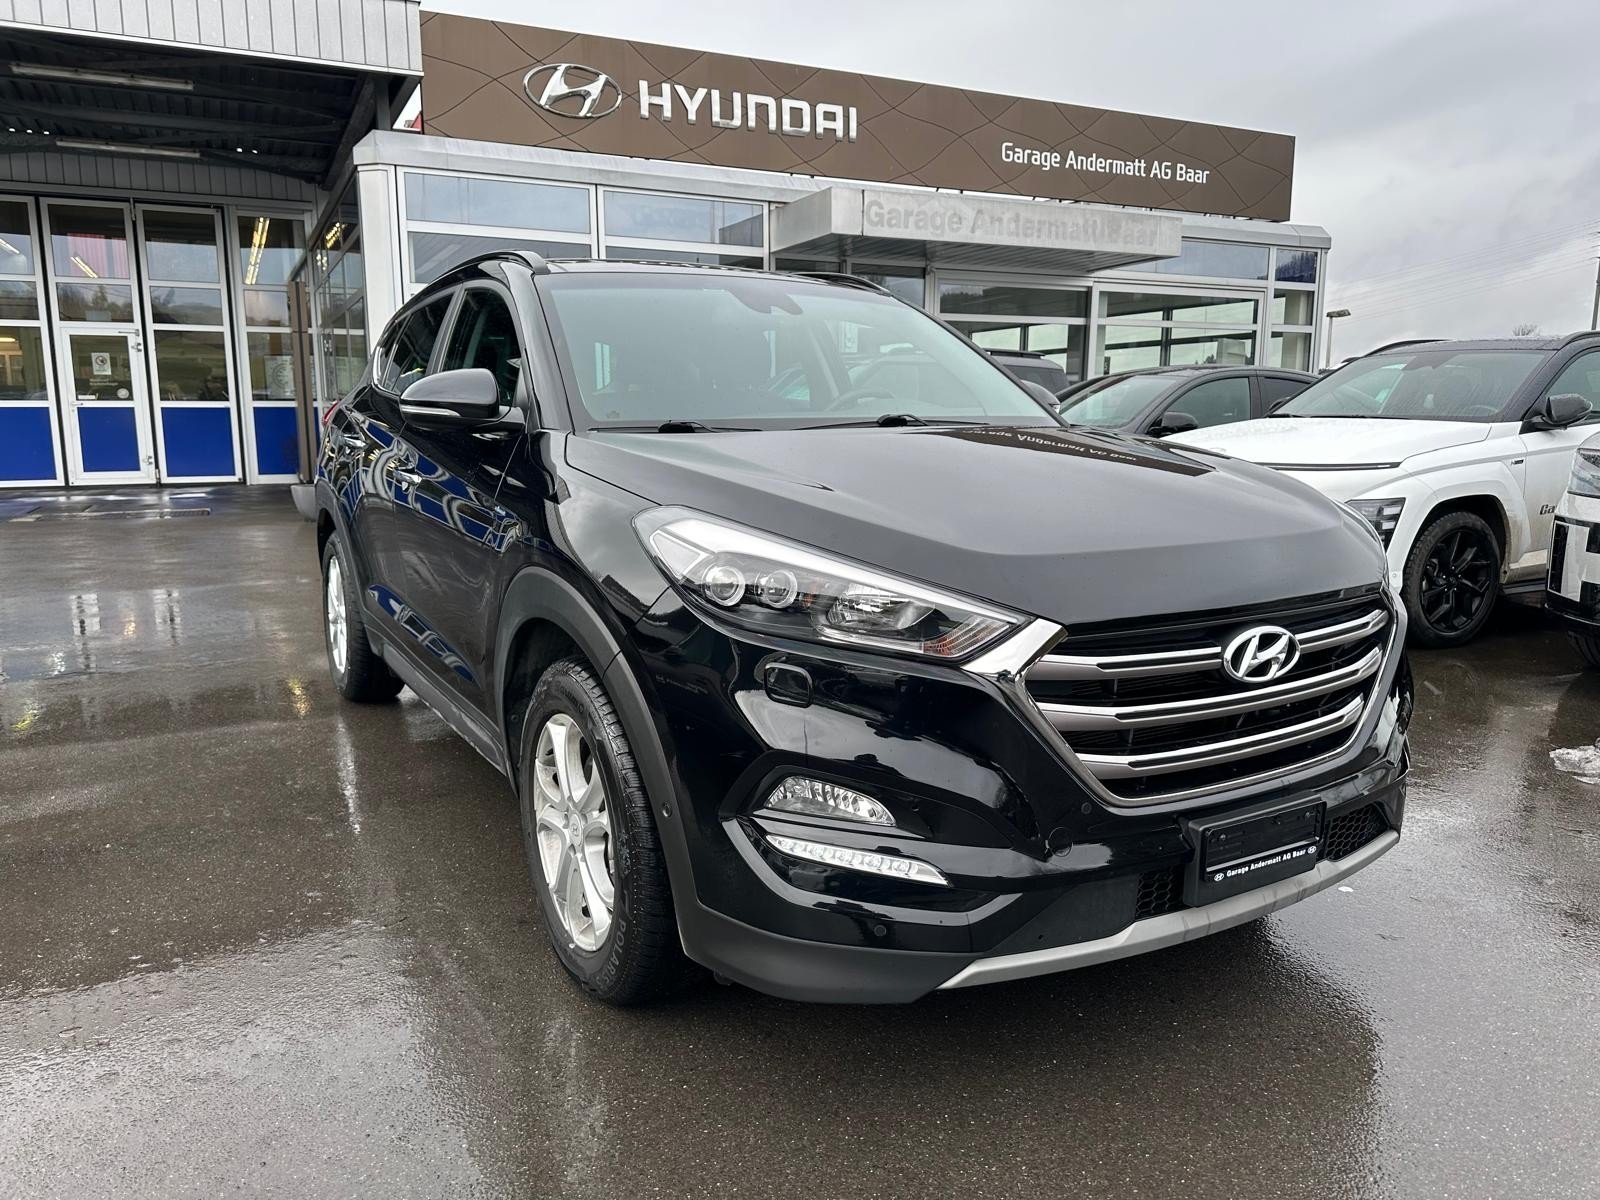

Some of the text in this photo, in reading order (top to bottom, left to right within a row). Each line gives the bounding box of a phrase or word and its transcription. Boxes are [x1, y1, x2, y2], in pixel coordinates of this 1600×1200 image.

[639, 79, 857, 143] HYUNDAI
[1001, 142, 1210, 184] Garage Andermatt AG Baar
[864, 199, 963, 236] Garage
[969, 208, 1101, 244] Andermatt
[1226, 849, 1306, 877] Garage Andermatt AG Baar
[602, 918, 627, 985] POLARIS
